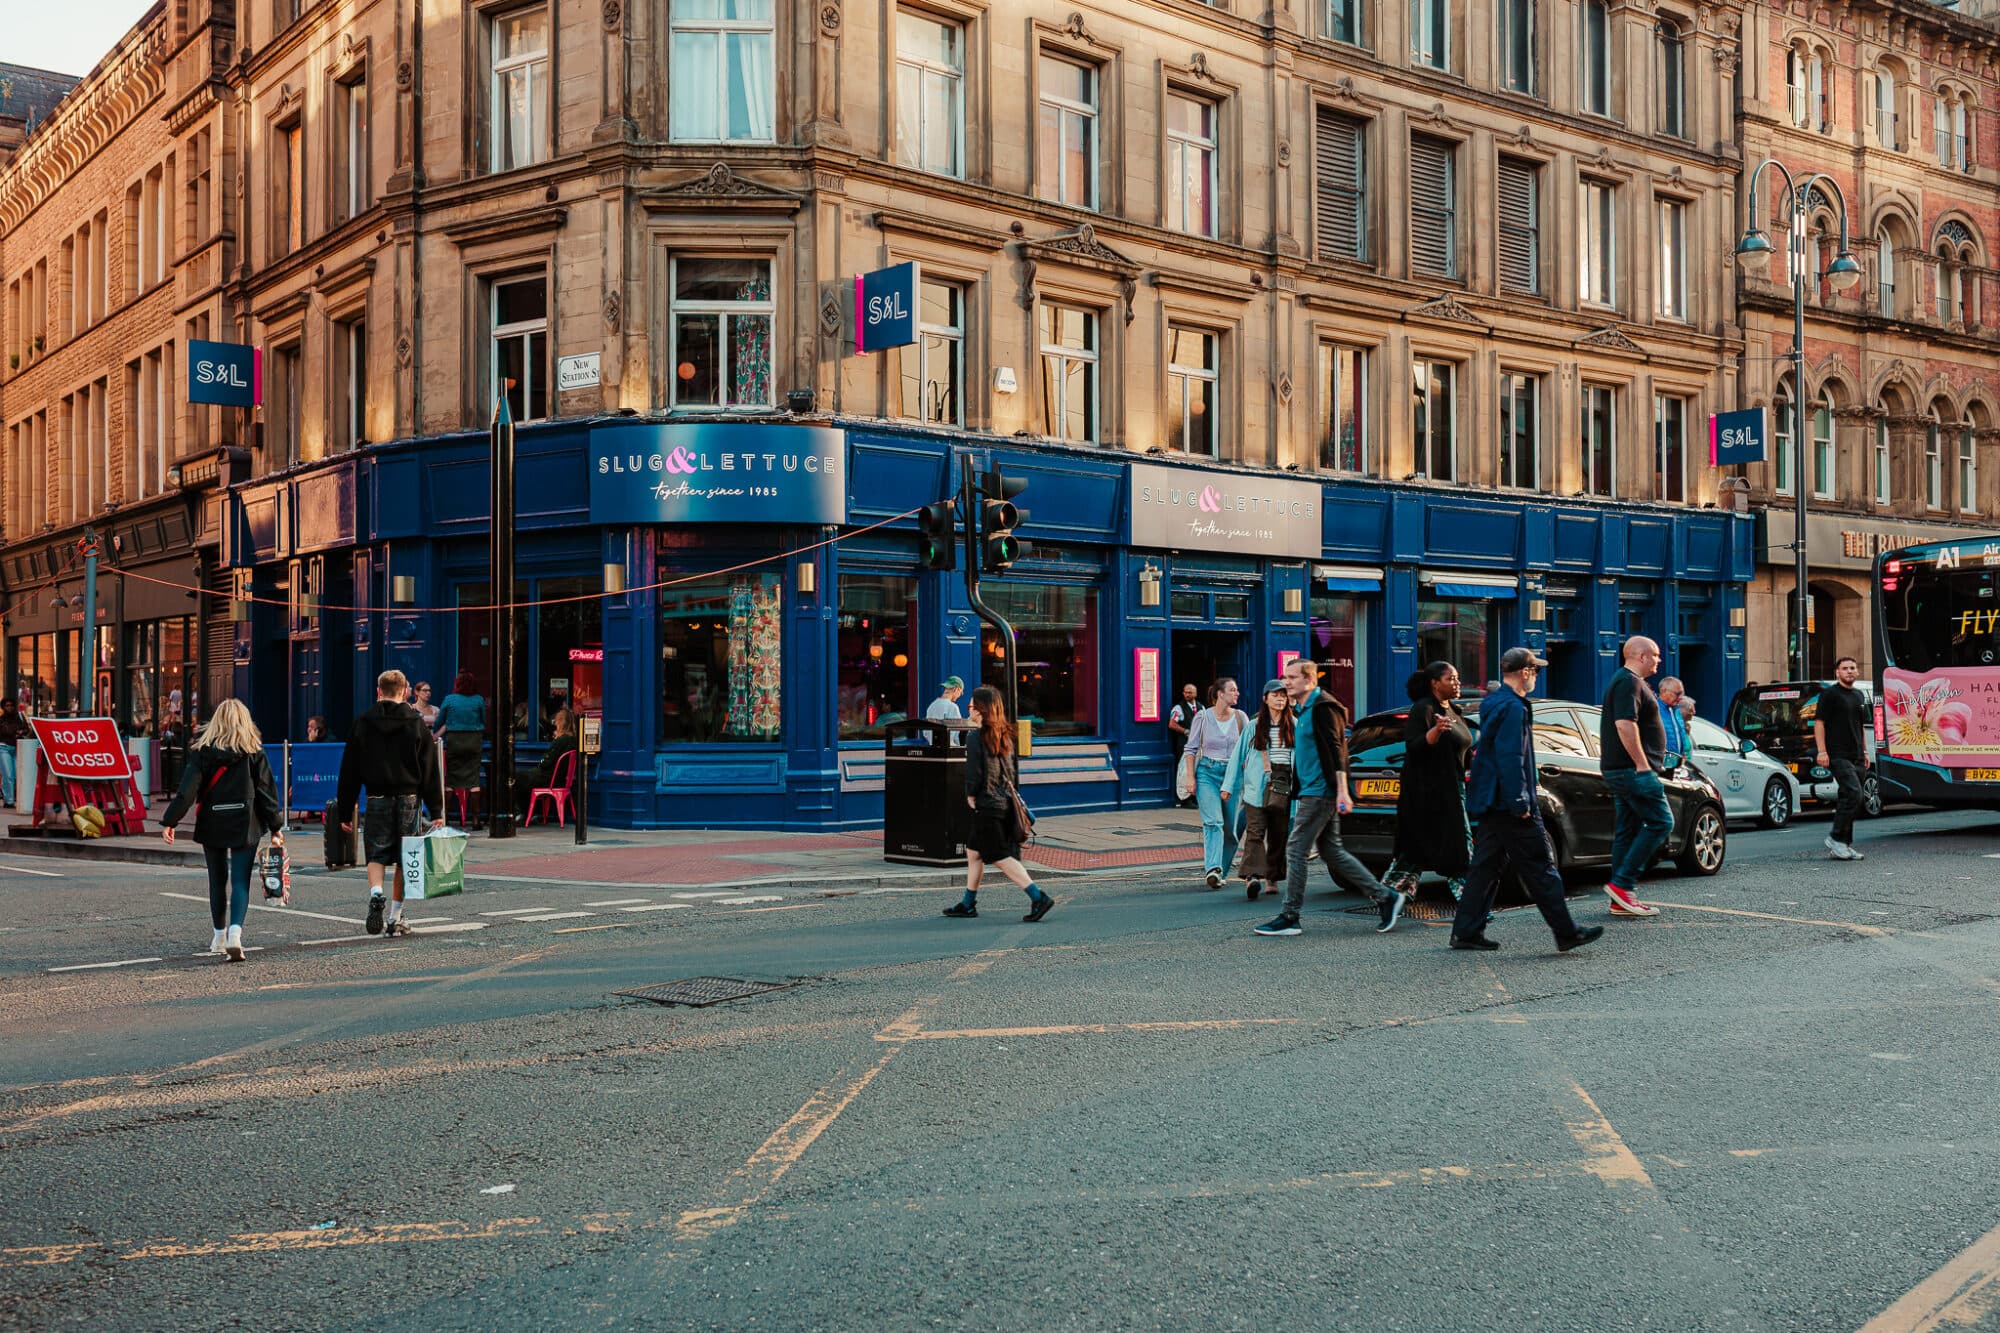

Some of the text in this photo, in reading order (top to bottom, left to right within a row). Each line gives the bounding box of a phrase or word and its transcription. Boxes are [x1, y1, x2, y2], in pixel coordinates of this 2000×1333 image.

[869, 291, 907, 324] S&L
[196, 360, 247, 387] S&L
[562, 372, 590, 382] STATION
[1721, 426, 1759, 448] S&L
[650, 481, 778, 500] together since 1985
[1186, 518, 1273, 539] together since 1985
[1841, 530, 1874, 559] THE
[1936, 546, 1960, 569] A1
[1971, 682, 2000, 693] HA
[52, 730, 99, 744] ROAD
[55, 752, 115, 767] CLOSED
[1972, 770, 1997, 779] BV25
[1367, 781, 1390, 792] FN10
[407, 849, 420, 884] 1864
